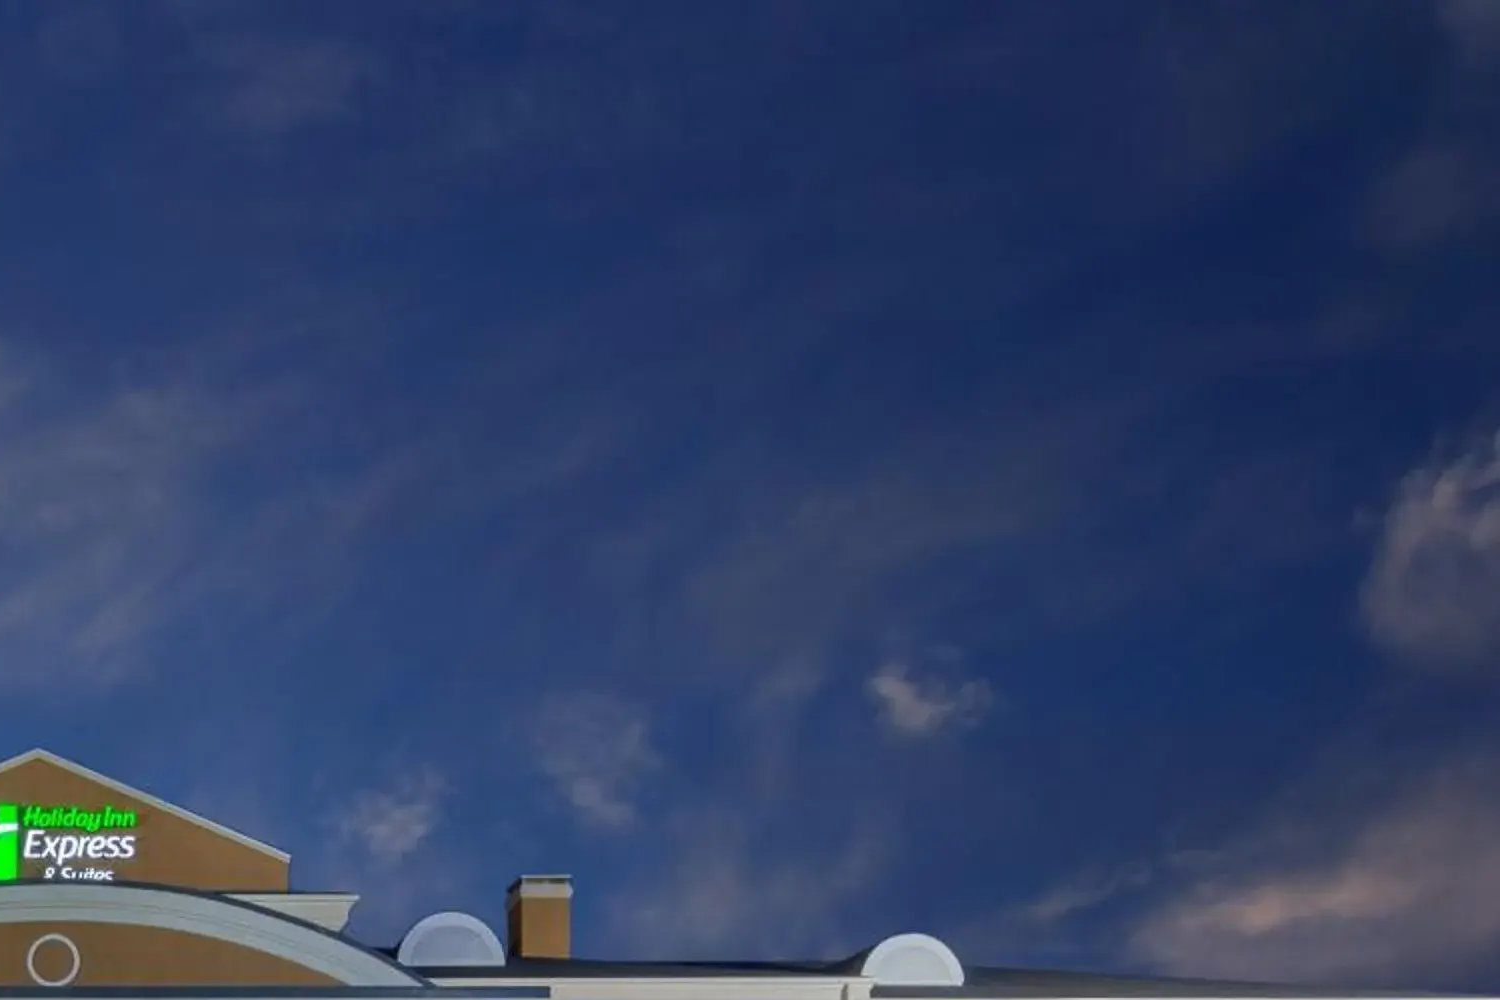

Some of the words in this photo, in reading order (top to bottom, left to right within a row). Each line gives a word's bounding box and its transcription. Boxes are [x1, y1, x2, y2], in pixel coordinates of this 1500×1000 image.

[23, 805, 101, 832] Holiday
[103, 805, 136, 827] Inn
[23, 829, 136, 865] Express
